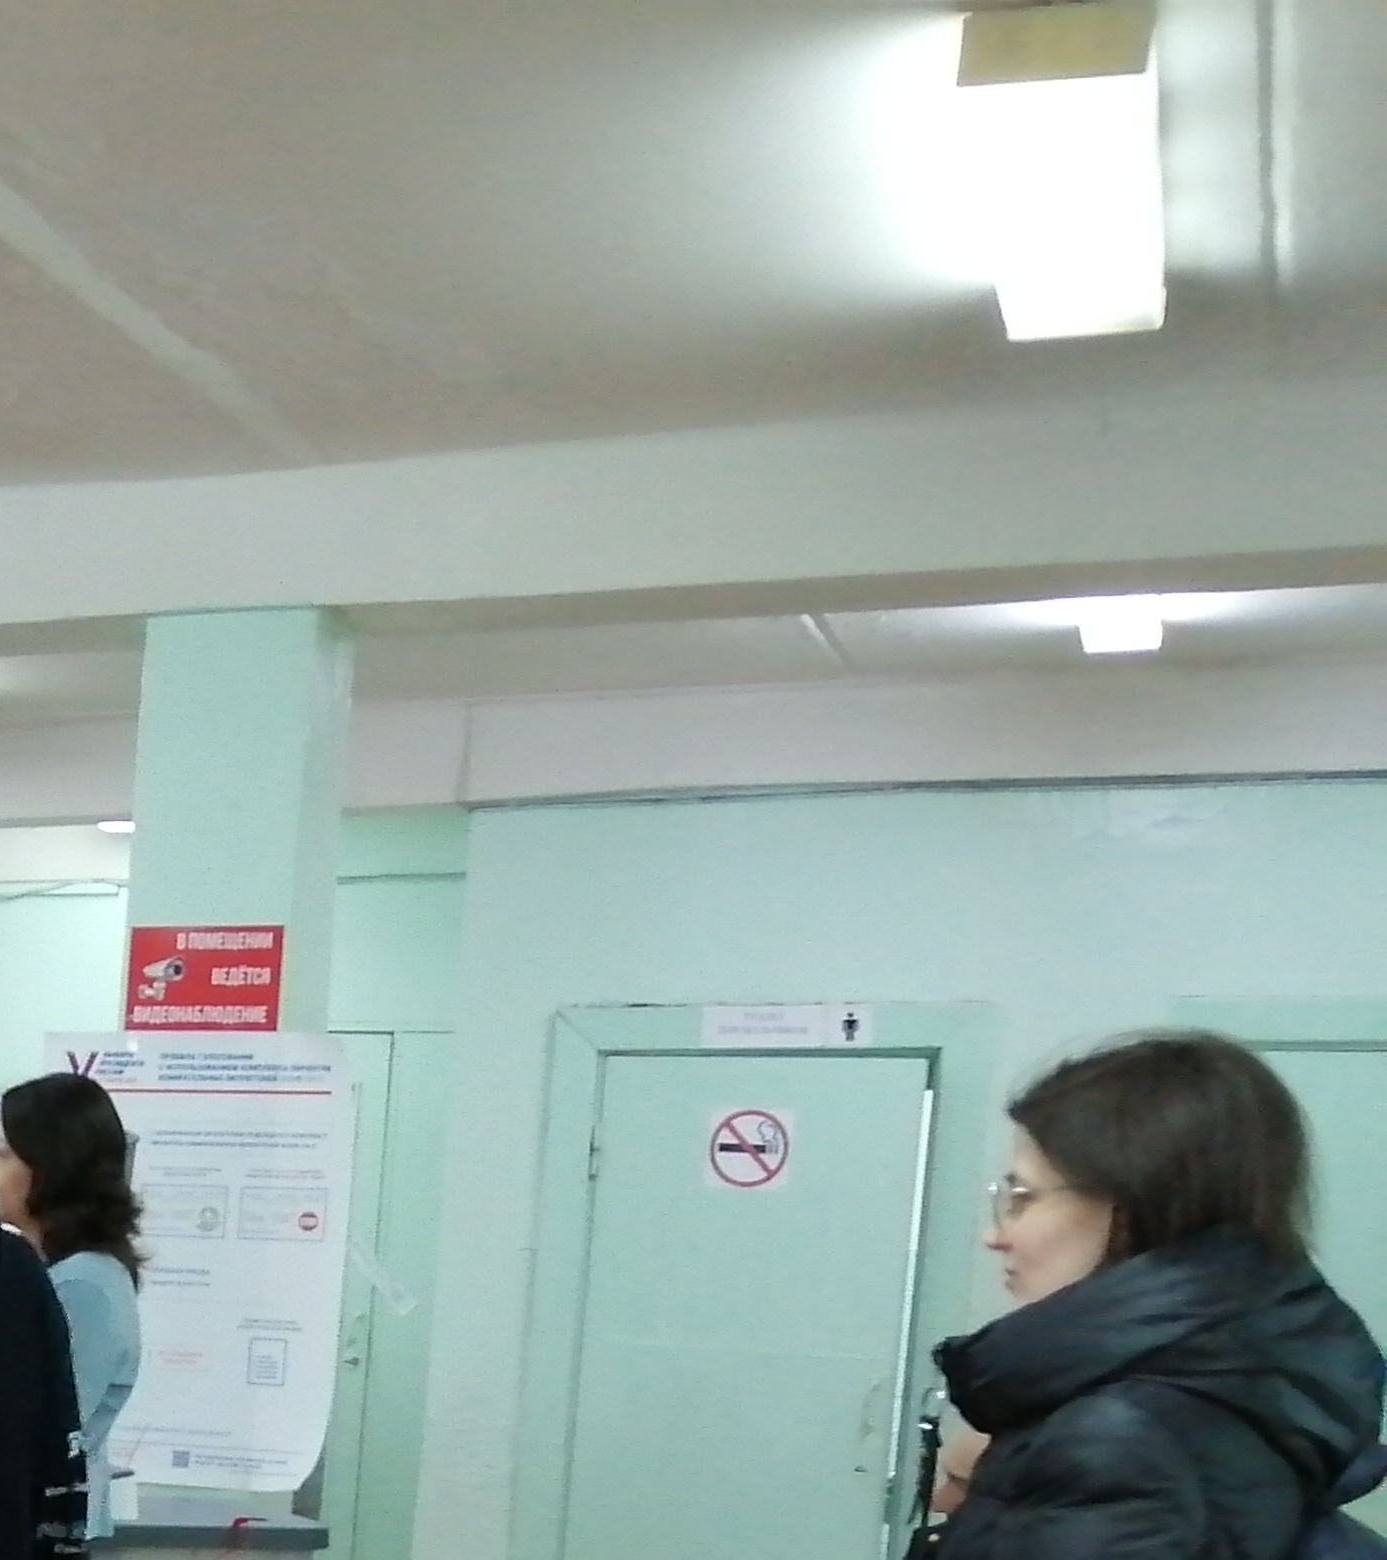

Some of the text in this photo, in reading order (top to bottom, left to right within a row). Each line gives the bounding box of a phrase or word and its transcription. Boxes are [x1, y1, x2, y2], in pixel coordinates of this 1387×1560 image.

[177, 931, 274, 950] В ПОМЕЩЕНИИ
[211, 964, 271, 986] ВЕДЁТСЯ
[133, 1005, 268, 1025] ВИДЕОНАБЛЮДЕНИЕ
